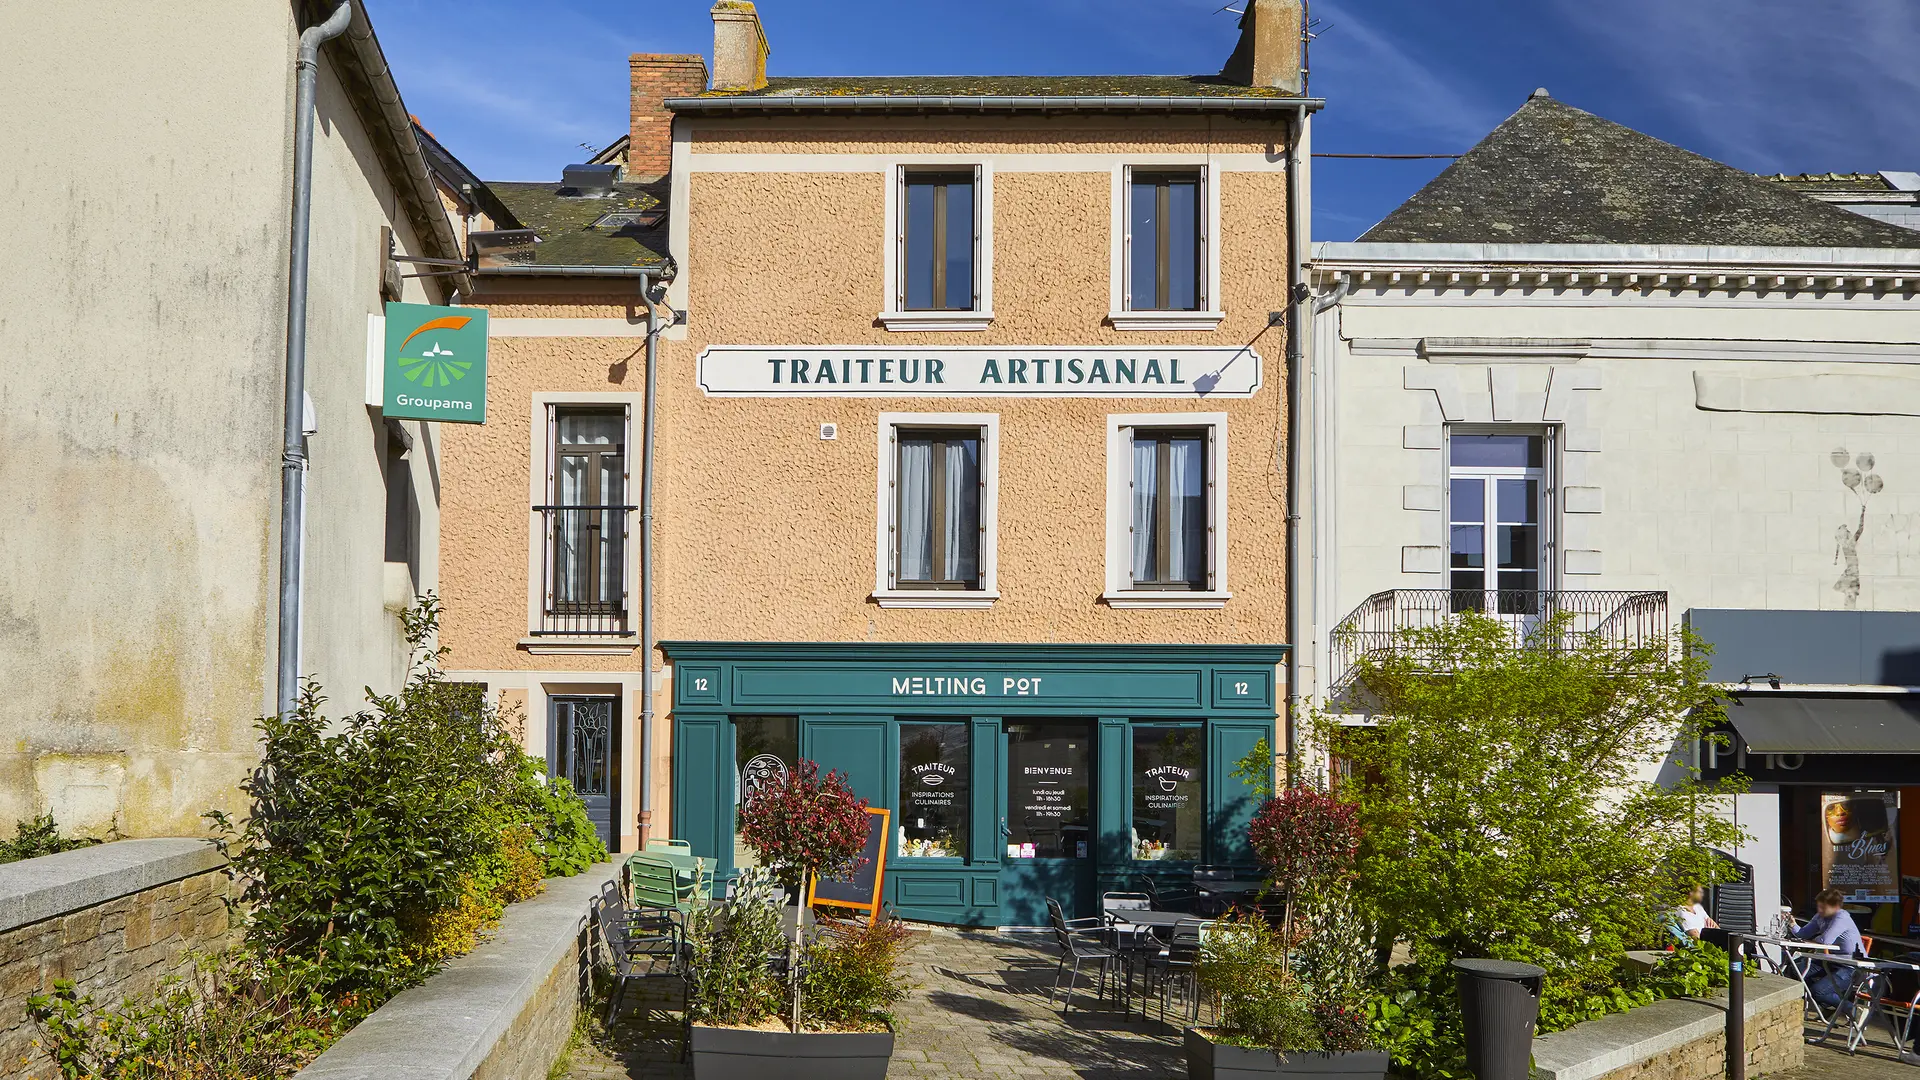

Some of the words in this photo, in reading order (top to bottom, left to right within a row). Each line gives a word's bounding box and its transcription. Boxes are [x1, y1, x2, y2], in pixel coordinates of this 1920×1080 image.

[767, 358, 947, 385] TRAITEUR
[979, 358, 1188, 385] ARTISANAL
[396, 394, 473, 410] Groupama
[694, 678, 708, 691] 12
[892, 677, 986, 695] MELTING
[1003, 677, 1042, 695] POT
[1234, 682, 1248, 695] 12
[911, 763, 956, 775] TRAITEUR
[1024, 767, 1073, 775] BIENVENUE
[1144, 766, 1190, 779] TRAITEUR
[1144, 794, 1189, 802] INSPIRATIONS
[1847, 836, 1887, 859] Blues
